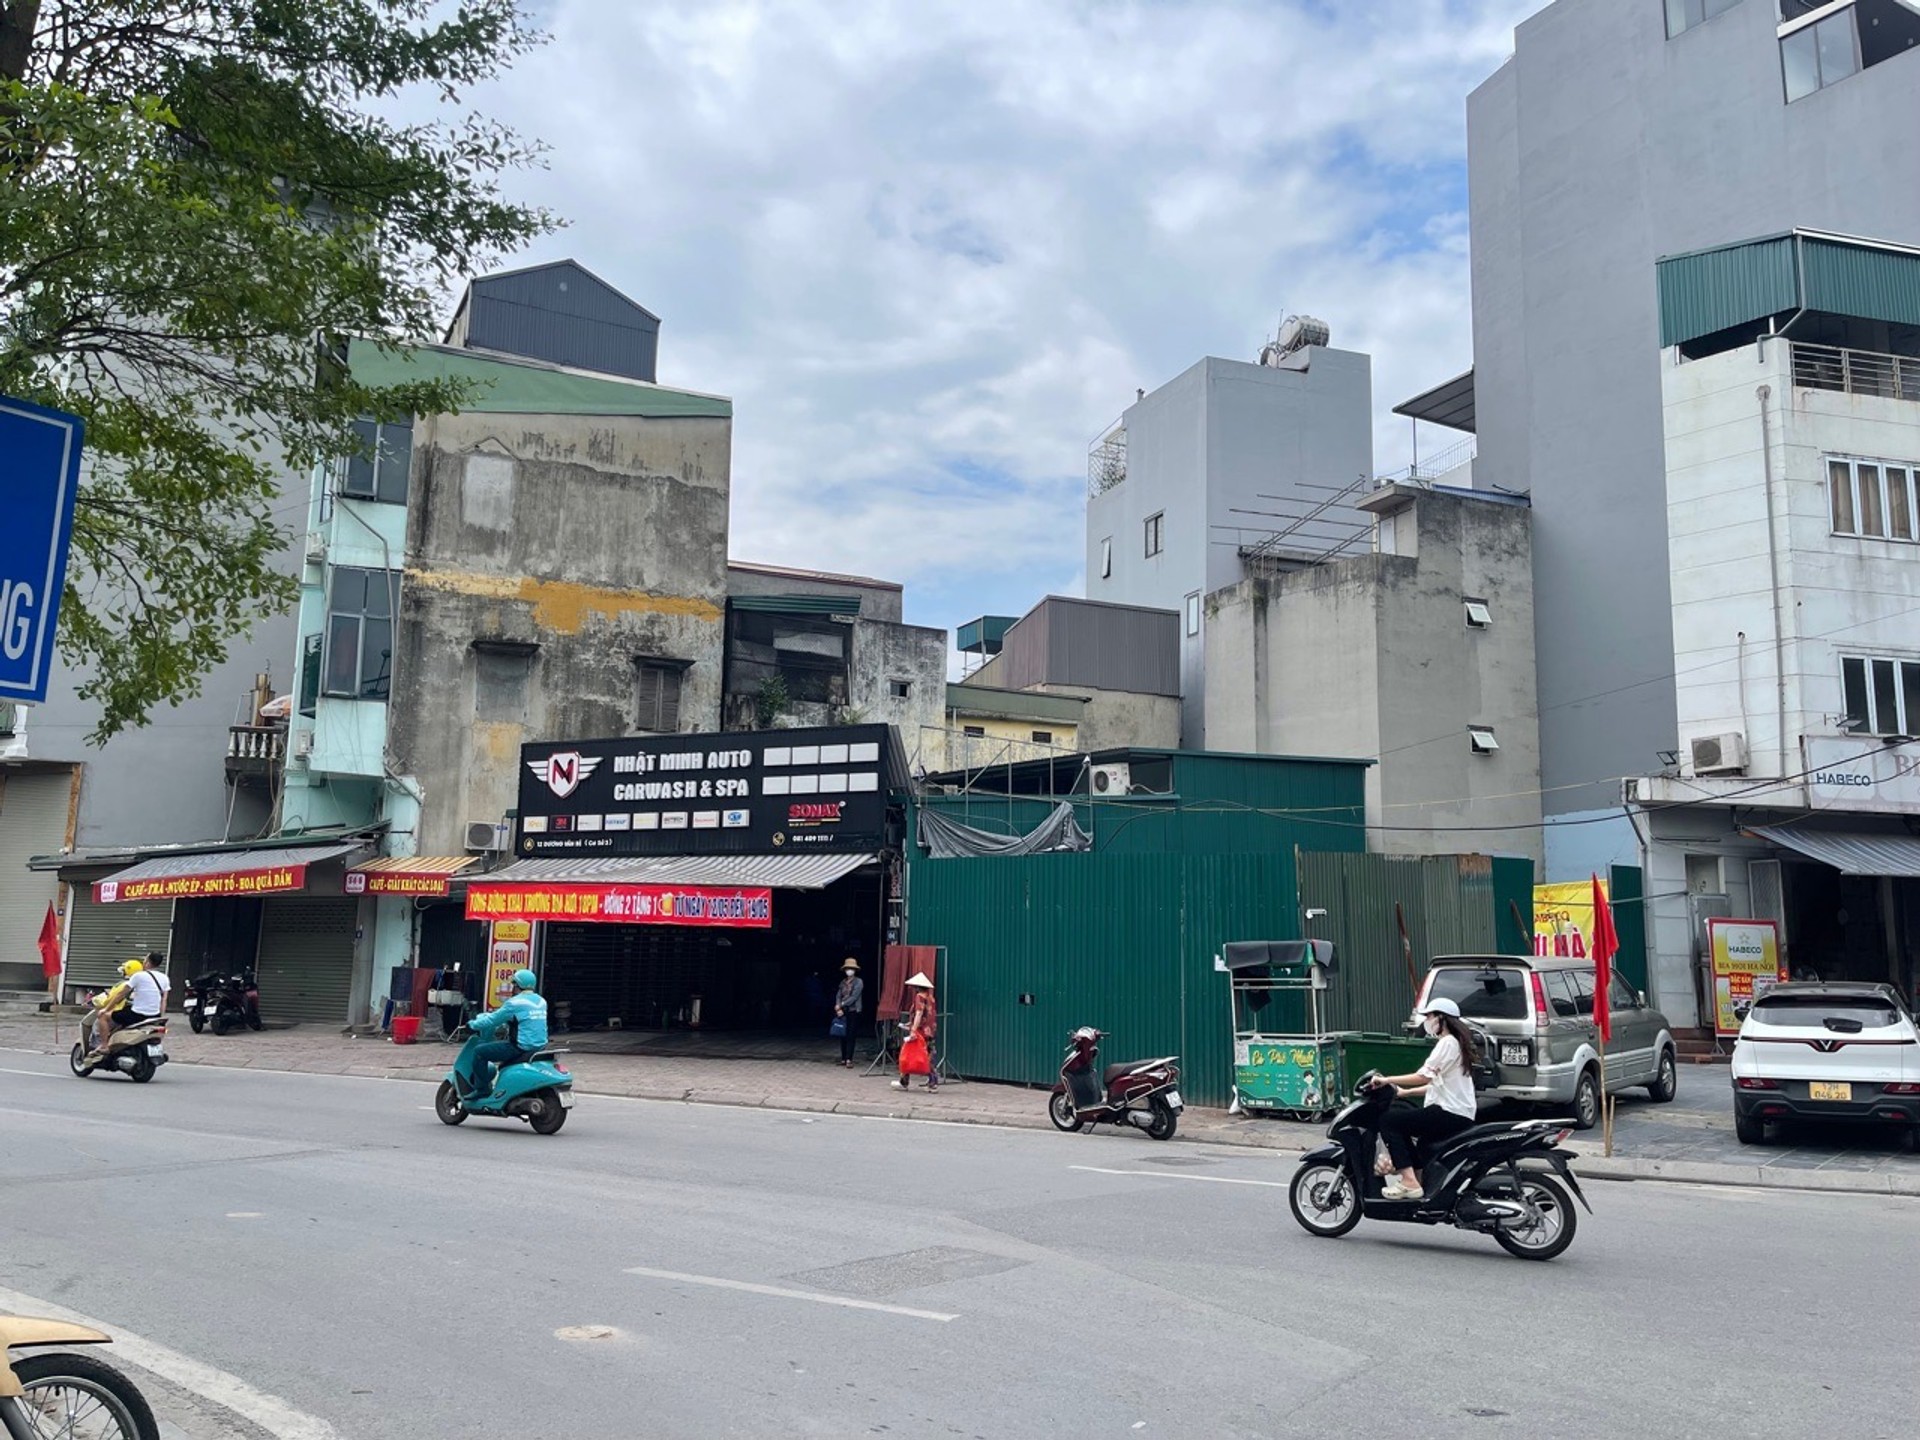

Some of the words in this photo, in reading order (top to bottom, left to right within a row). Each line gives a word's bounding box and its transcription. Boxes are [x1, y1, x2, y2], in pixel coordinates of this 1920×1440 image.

[0, 579, 34, 660] G
[613, 751, 656, 775] NHẬT
[660, 752, 703, 771] MINH
[707, 749, 752, 770] AUTO
[1816, 773, 1871, 786] HABECO
[613, 780, 697, 801] CARWASH
[700, 780, 712, 798] &
[715, 779, 749, 797] SPA
[788, 803, 841, 817] SONAX
[625, 895, 631, 915] 2
[495, 949, 508, 963] BIA
[1728, 946, 1762, 954] HABECO
[495, 968, 516, 981] 18P
